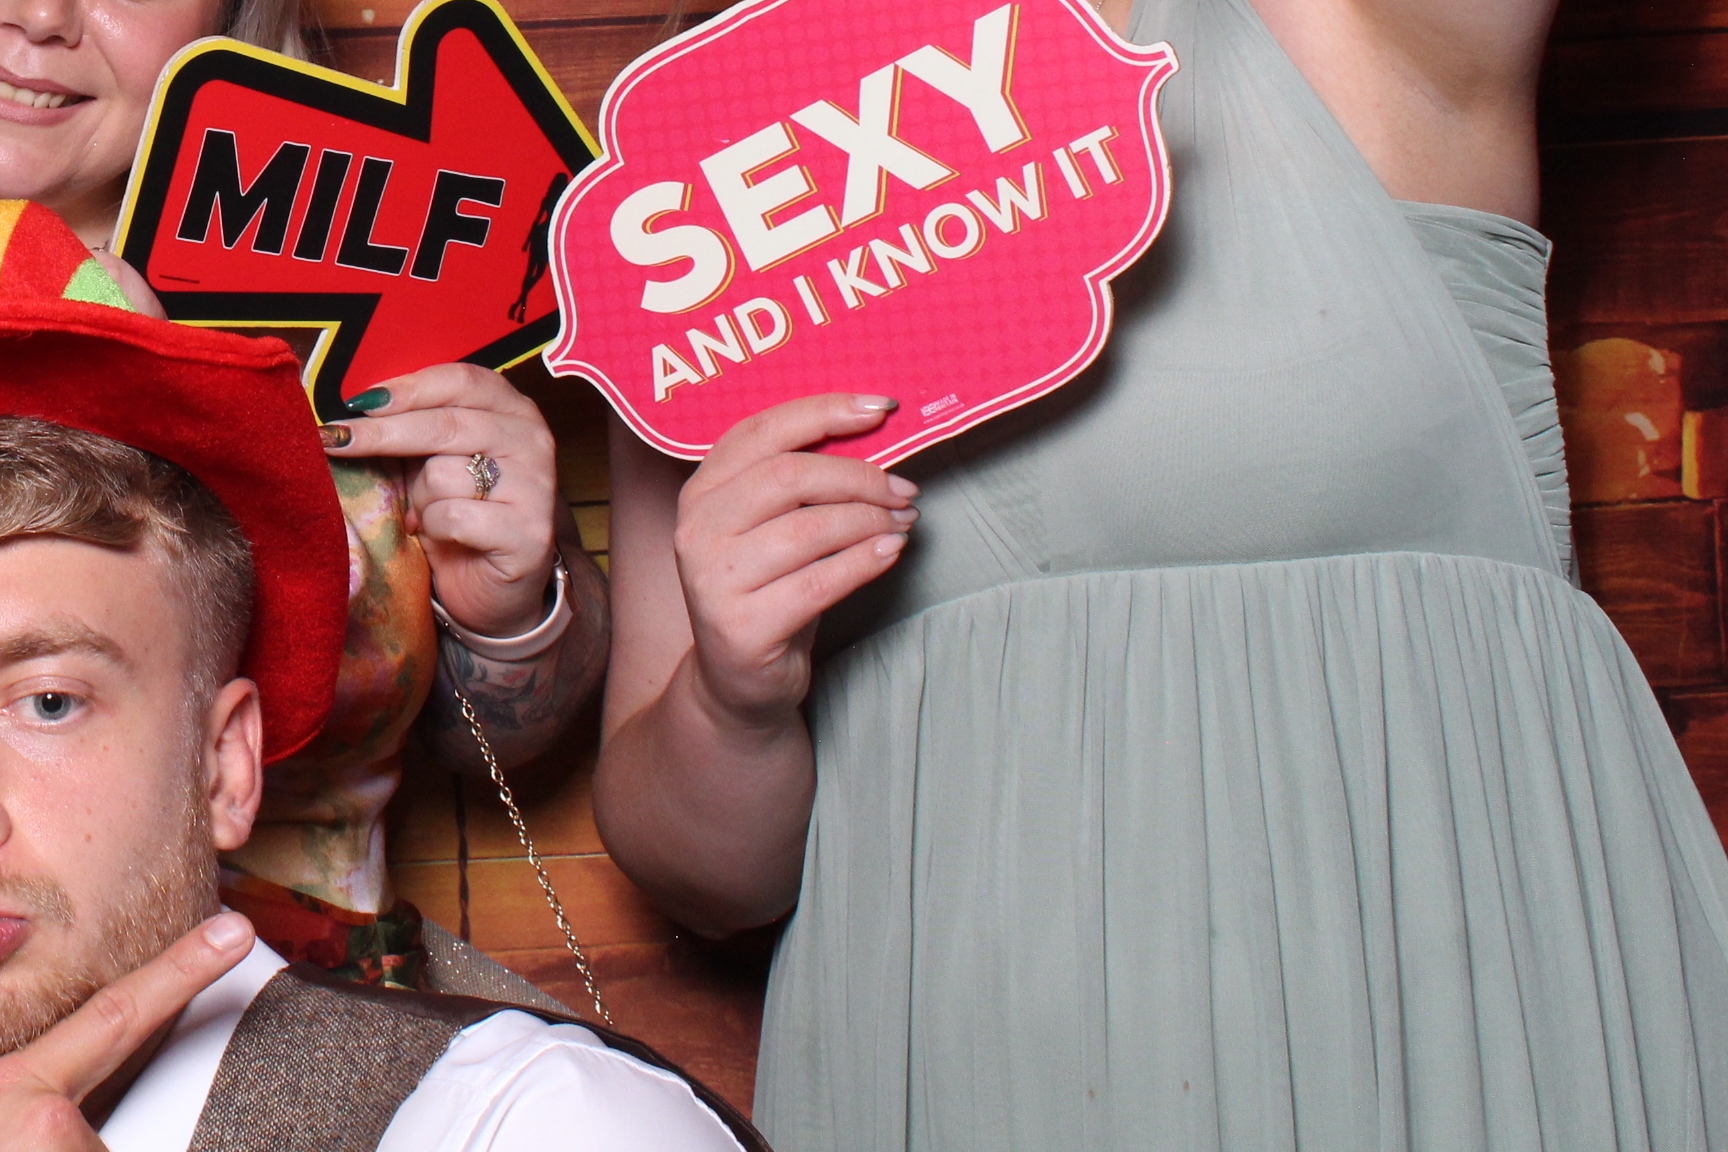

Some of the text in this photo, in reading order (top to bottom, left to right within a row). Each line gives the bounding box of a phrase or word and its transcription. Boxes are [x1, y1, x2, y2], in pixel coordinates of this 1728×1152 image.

[176, 127, 506, 282] MILF
[610, 3, 1031, 315] SEXY
[651, 125, 1124, 403] AND I KNOW IT
